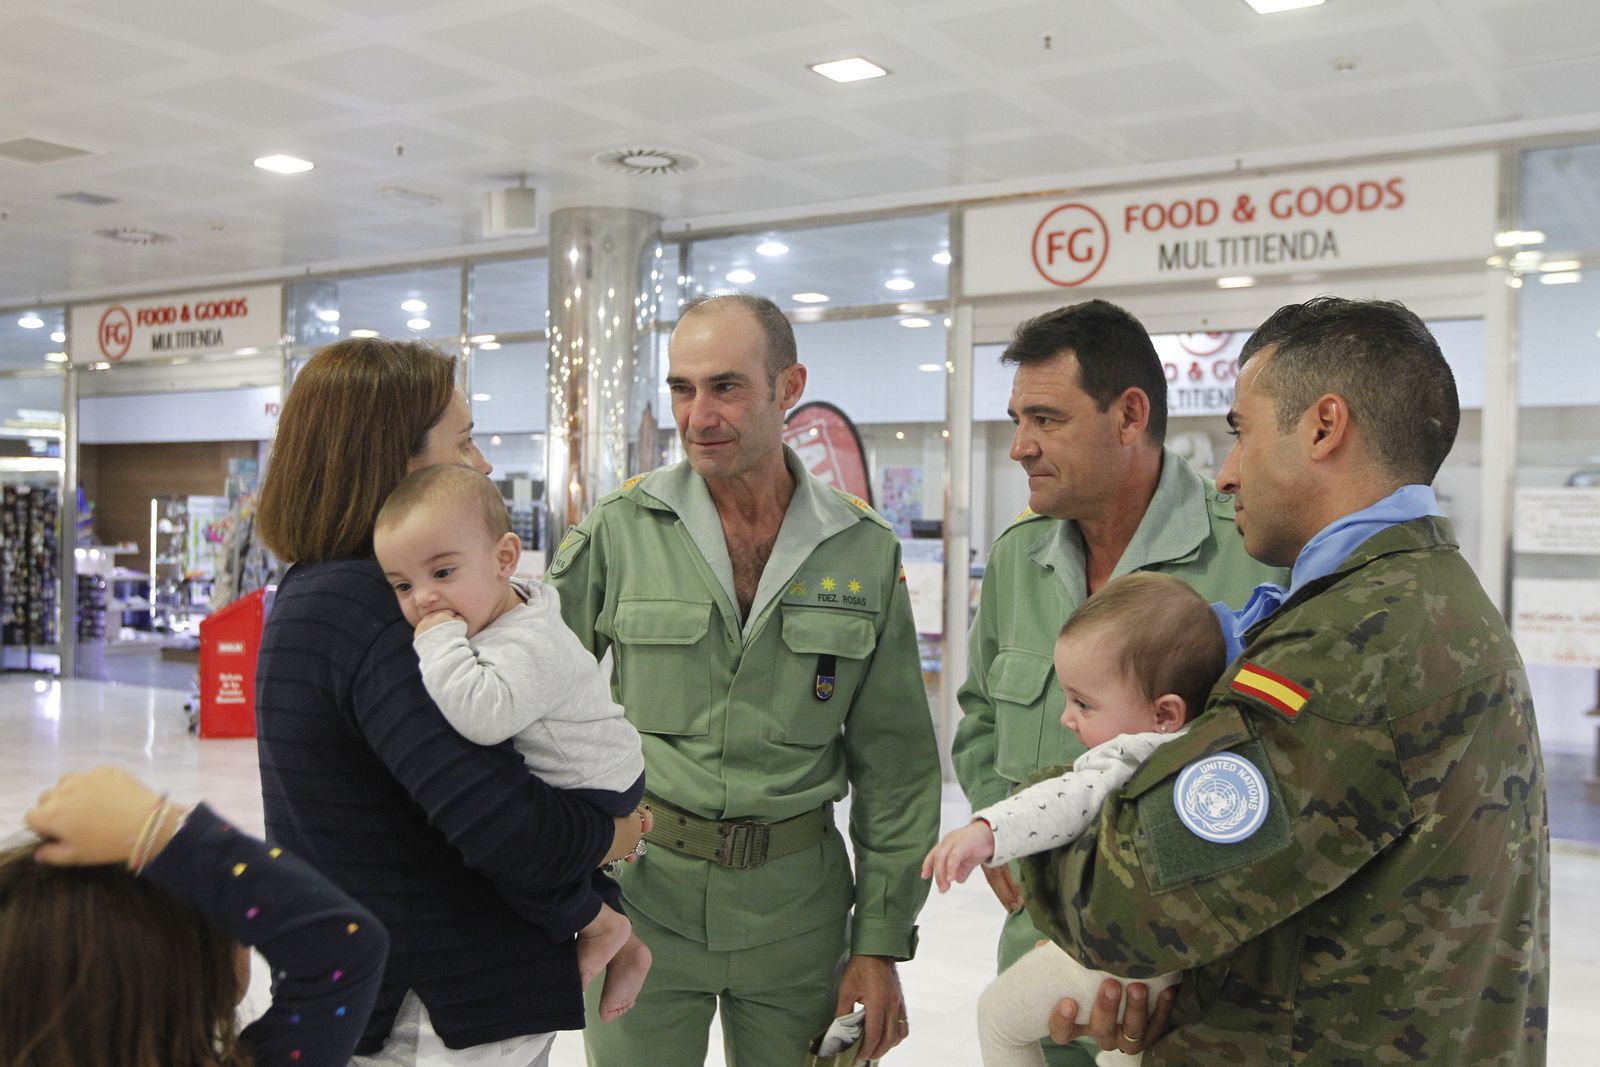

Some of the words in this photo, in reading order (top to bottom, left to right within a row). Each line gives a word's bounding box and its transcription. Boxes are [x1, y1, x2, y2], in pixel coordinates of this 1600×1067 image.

[1123, 198, 1219, 233] FOOD
[1232, 194, 1256, 223] &
[1269, 177, 1405, 220] GOODS
[1046, 227, 1094, 265] FG
[1158, 230, 1340, 272] MULTITIENDA
[137, 305, 177, 327] FOOD
[181, 304, 190, 322] &
[195, 298, 248, 321] GOODS
[105, 321, 127, 346] FG
[152, 328, 223, 352] MULTITIENDA
[842, 595, 866, 606] ROSAS
[1200, 761, 1237, 775] UNITED
[1237, 769, 1259, 811] NATIONS
